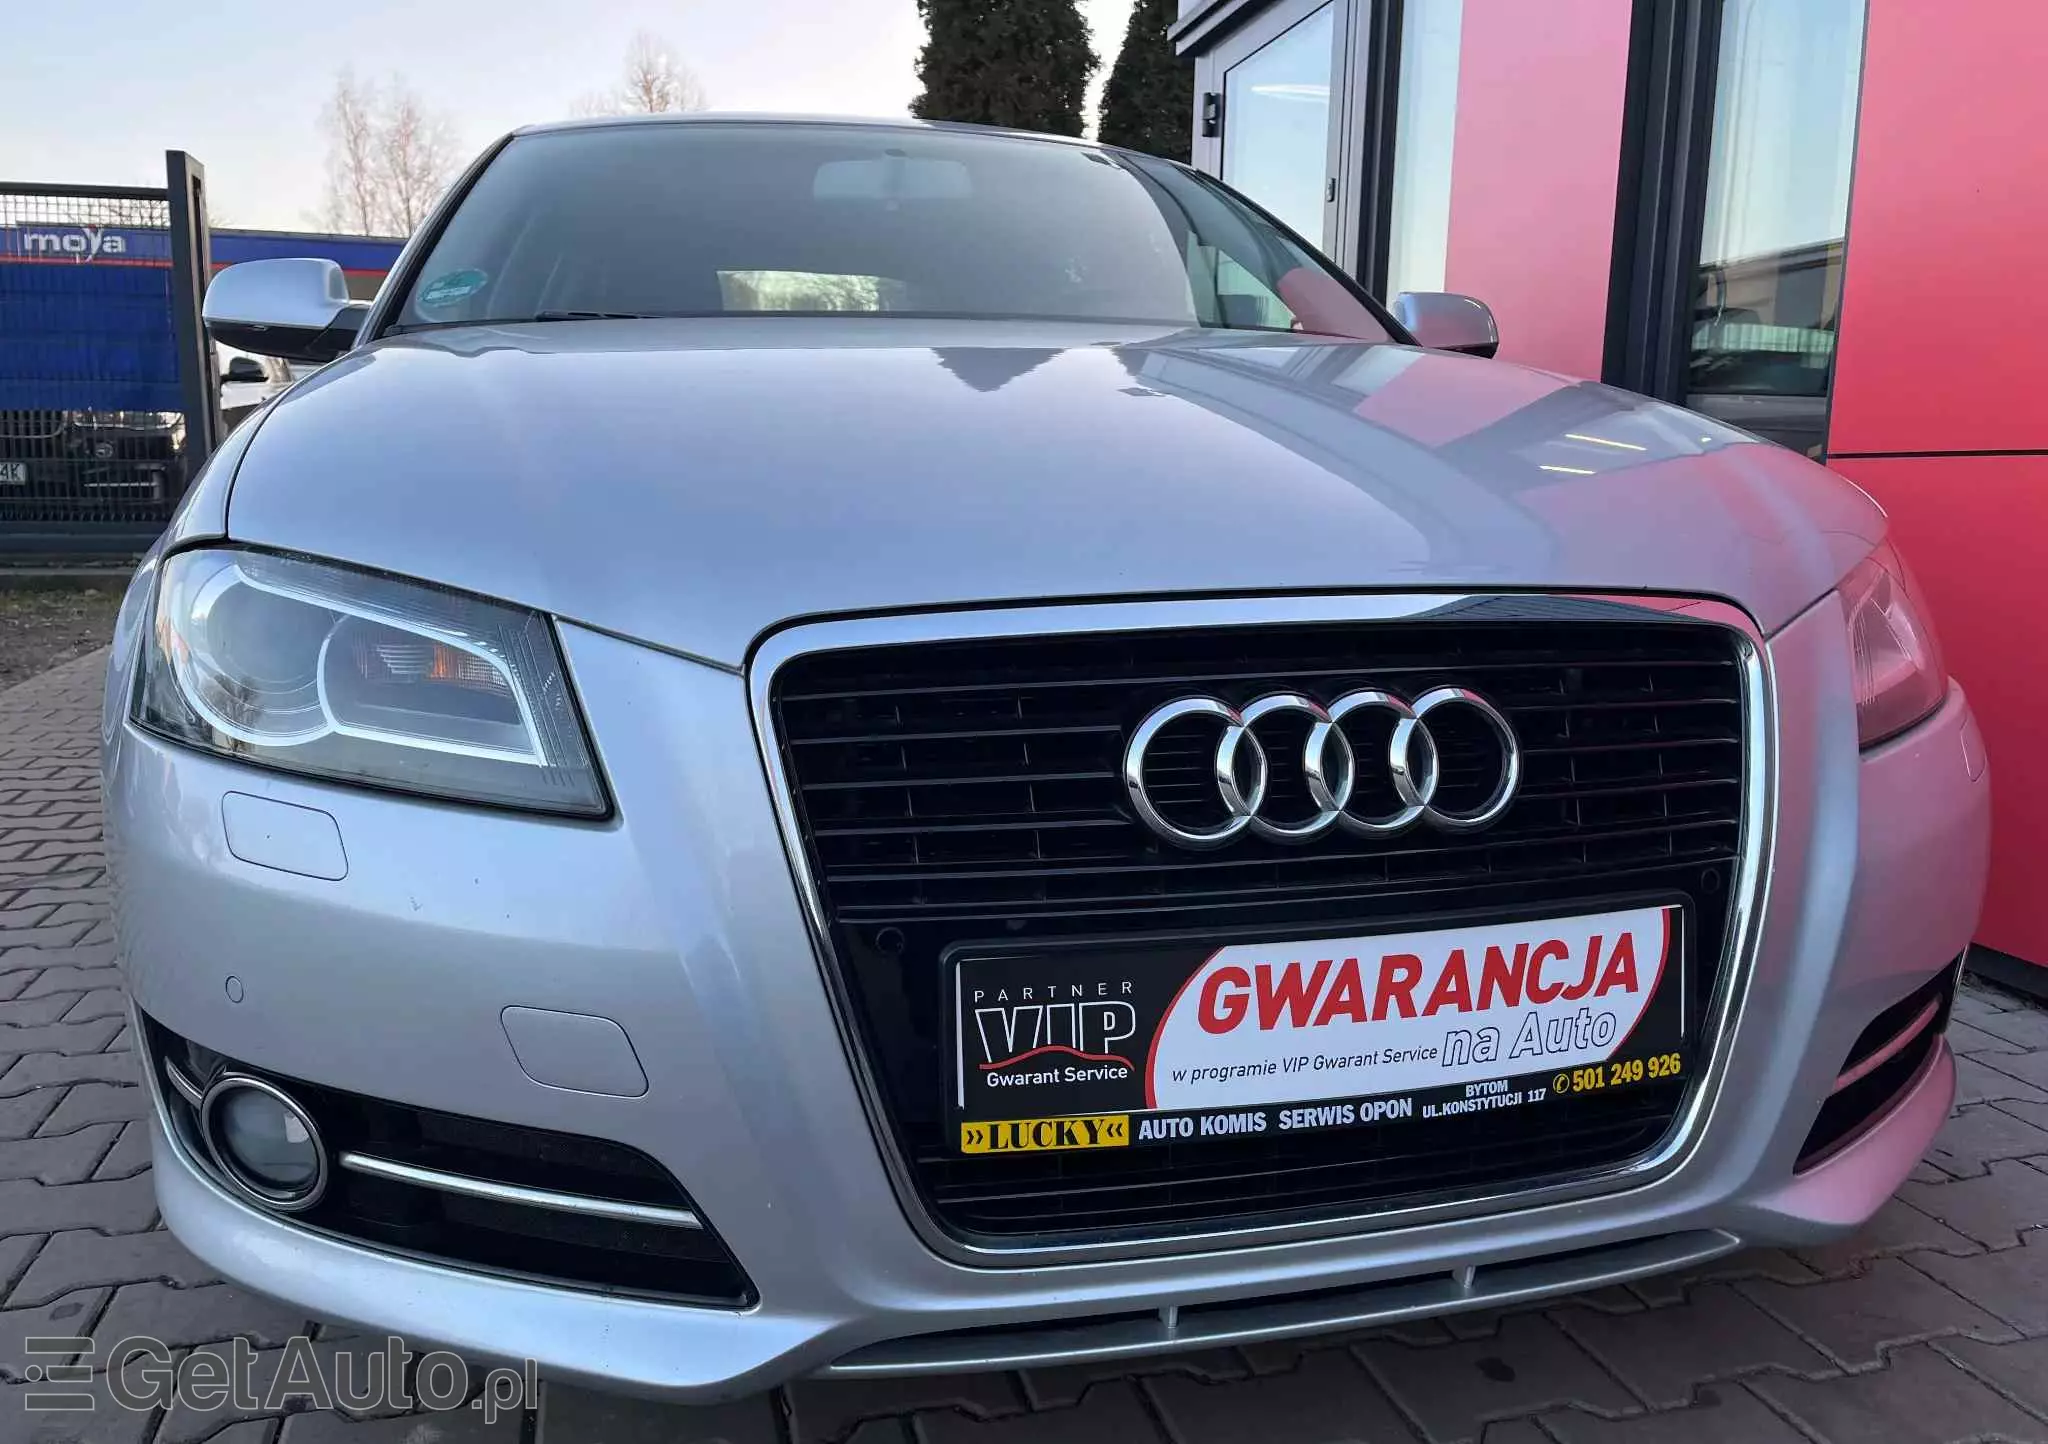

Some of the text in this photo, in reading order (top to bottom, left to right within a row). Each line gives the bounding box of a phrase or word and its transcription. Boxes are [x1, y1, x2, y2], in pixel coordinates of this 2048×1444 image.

[974, 981, 1133, 1003] PARTNER
[1197, 932, 1639, 1035] GWARANCJA
[975, 1001, 1136, 1063] VIP
[1441, 1007, 1617, 1067] na Auto
[986, 1065, 1129, 1088] Gwarant Service
[1172, 1044, 1438, 1085] w programie VIP Gwarant Service
[1572, 1053, 1682, 1092] 501 249 926
[1422, 1087, 1547, 1119] UL.KONSTYTUCJI 117
[1465, 1080, 1509, 1098] BYTOM
[1138, 1116, 1195, 1140] AUTO
[1200, 1112, 1268, 1136] KOMIS
[1278, 1104, 1356, 1131] SERWIS
[1359, 1097, 1413, 1122] OPON
